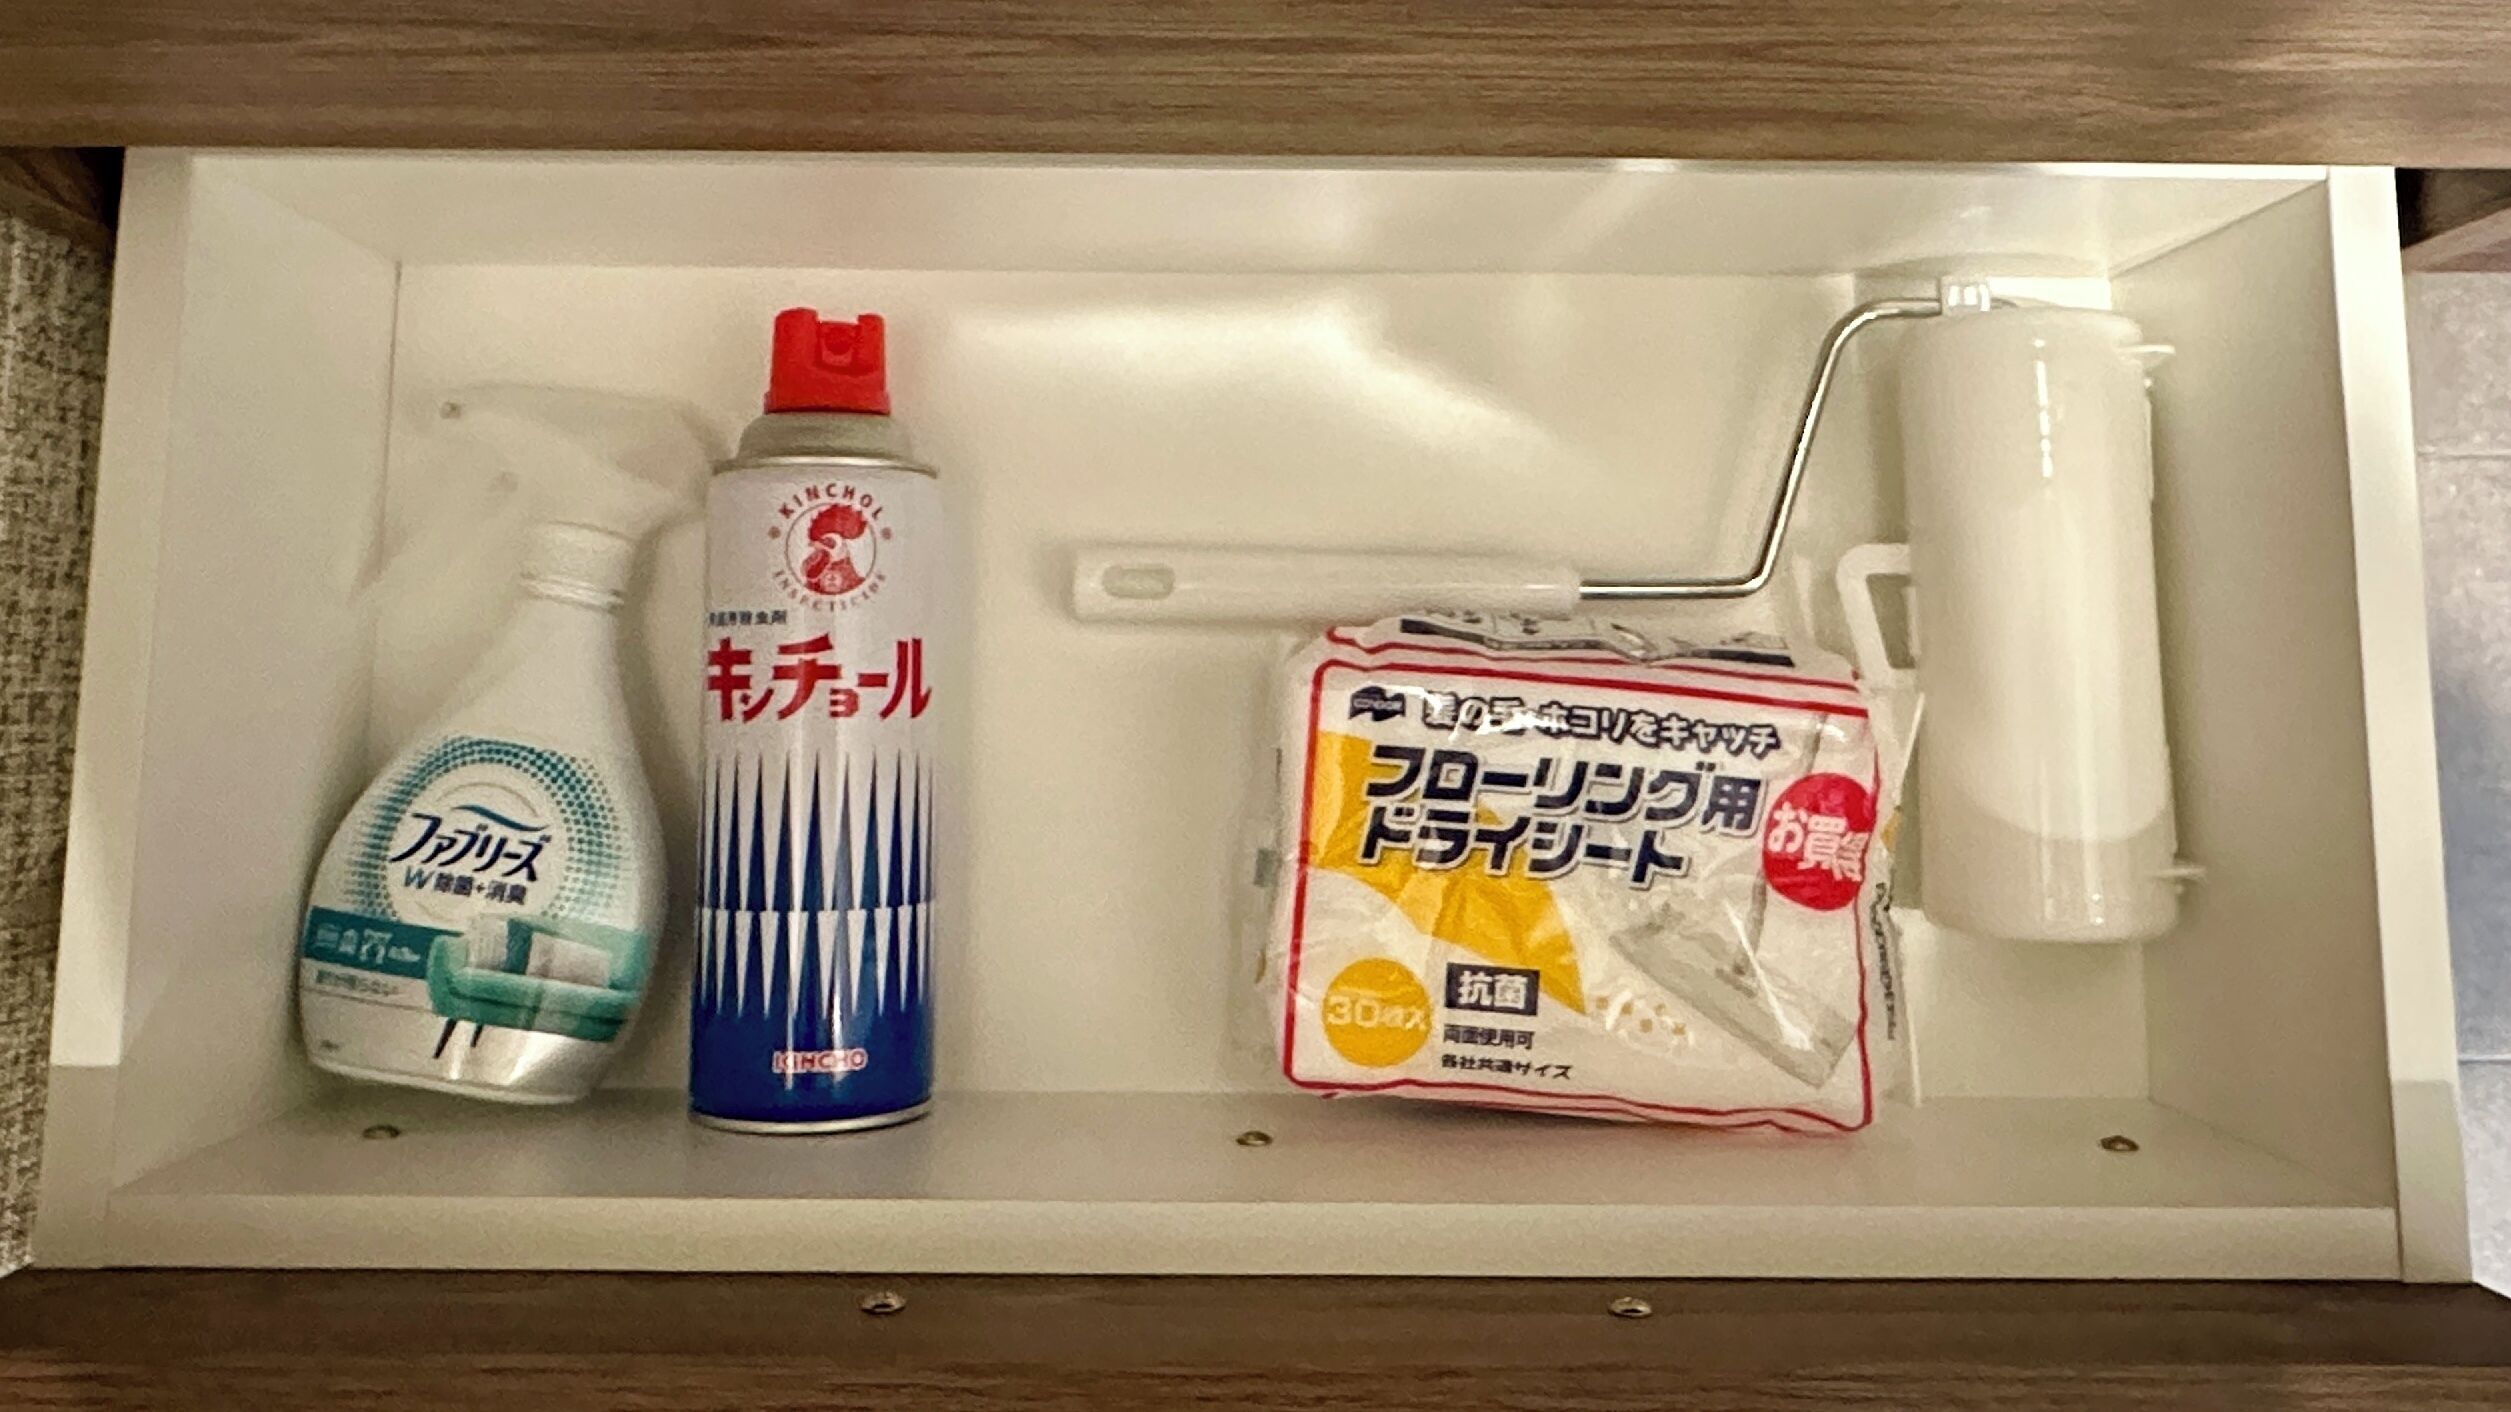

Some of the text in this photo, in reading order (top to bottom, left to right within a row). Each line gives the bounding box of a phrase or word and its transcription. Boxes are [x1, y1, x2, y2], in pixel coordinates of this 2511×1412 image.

[778, 483, 885, 520] KINCHOL
[707, 632, 932, 724] キンチョール
[1422, 691, 1781, 758] 髪の毛ホコリをキャッチ
[1366, 743, 1762, 832] フローリング用
[389, 812, 552, 882] ファブリーズ
[1361, 805, 1686, 885] ドライシート
[403, 865, 435, 889] W
[1458, 970, 1529, 1010] 抗菌
[1443, 1023, 1536, 1050] 両面使用可
[773, 1048, 868, 1073] KINCHO
[1441, 1053, 1573, 1080] 各社共通サイズ
